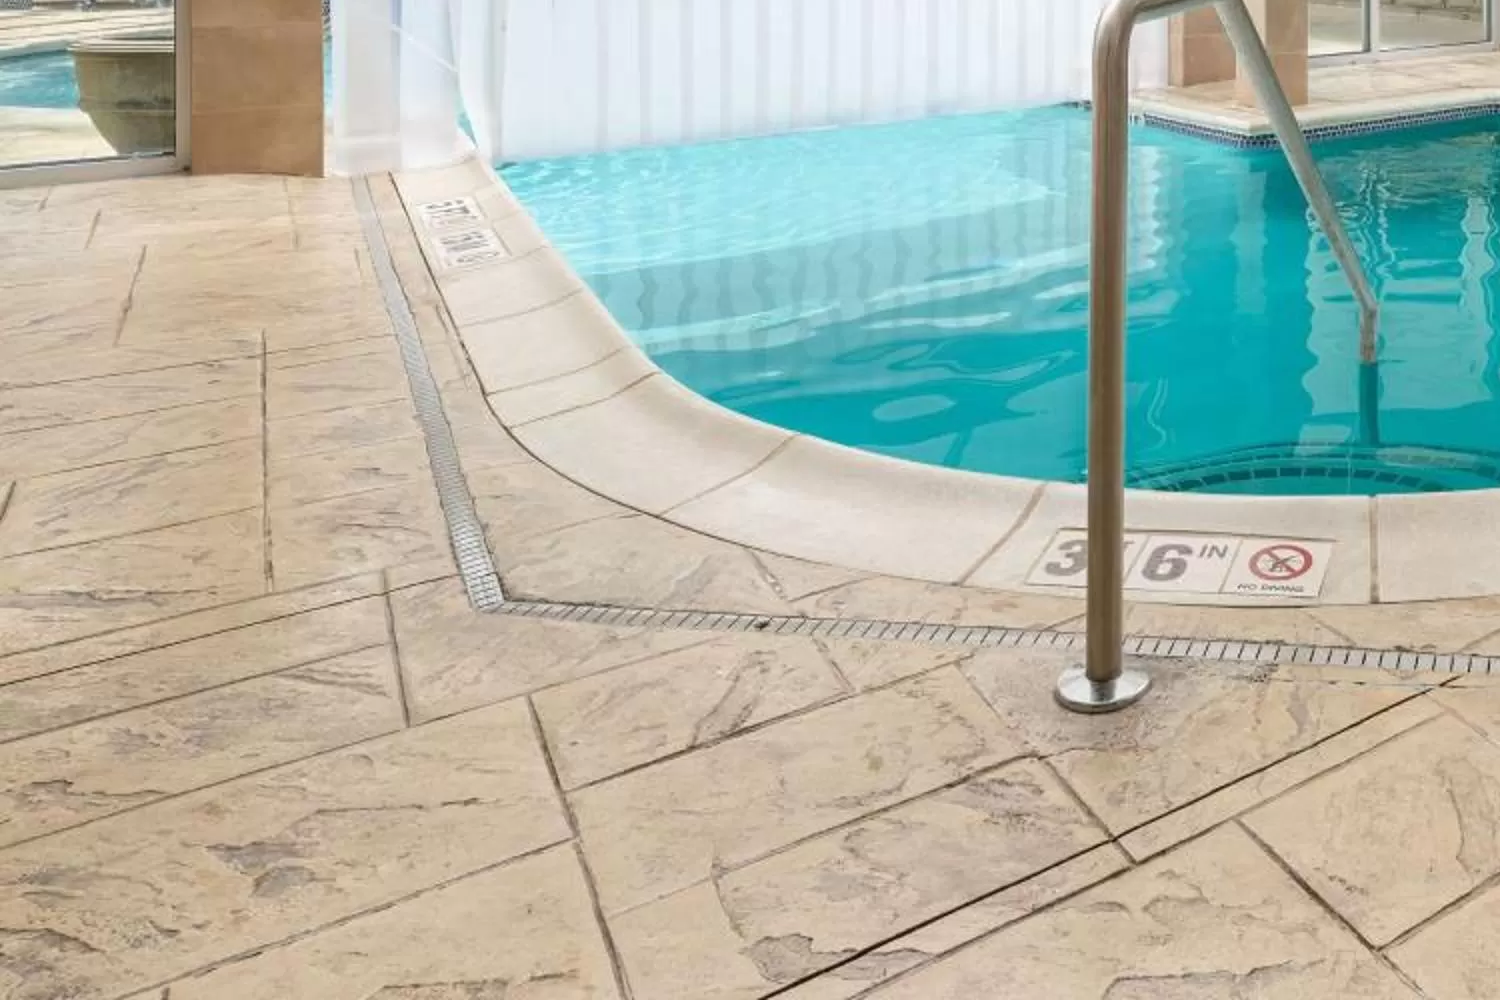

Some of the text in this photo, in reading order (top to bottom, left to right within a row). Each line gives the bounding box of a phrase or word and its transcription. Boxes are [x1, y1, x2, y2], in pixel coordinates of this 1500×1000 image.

[1141, 544, 1228, 581] 6 IN
[1237, 583, 1257, 591] NO
